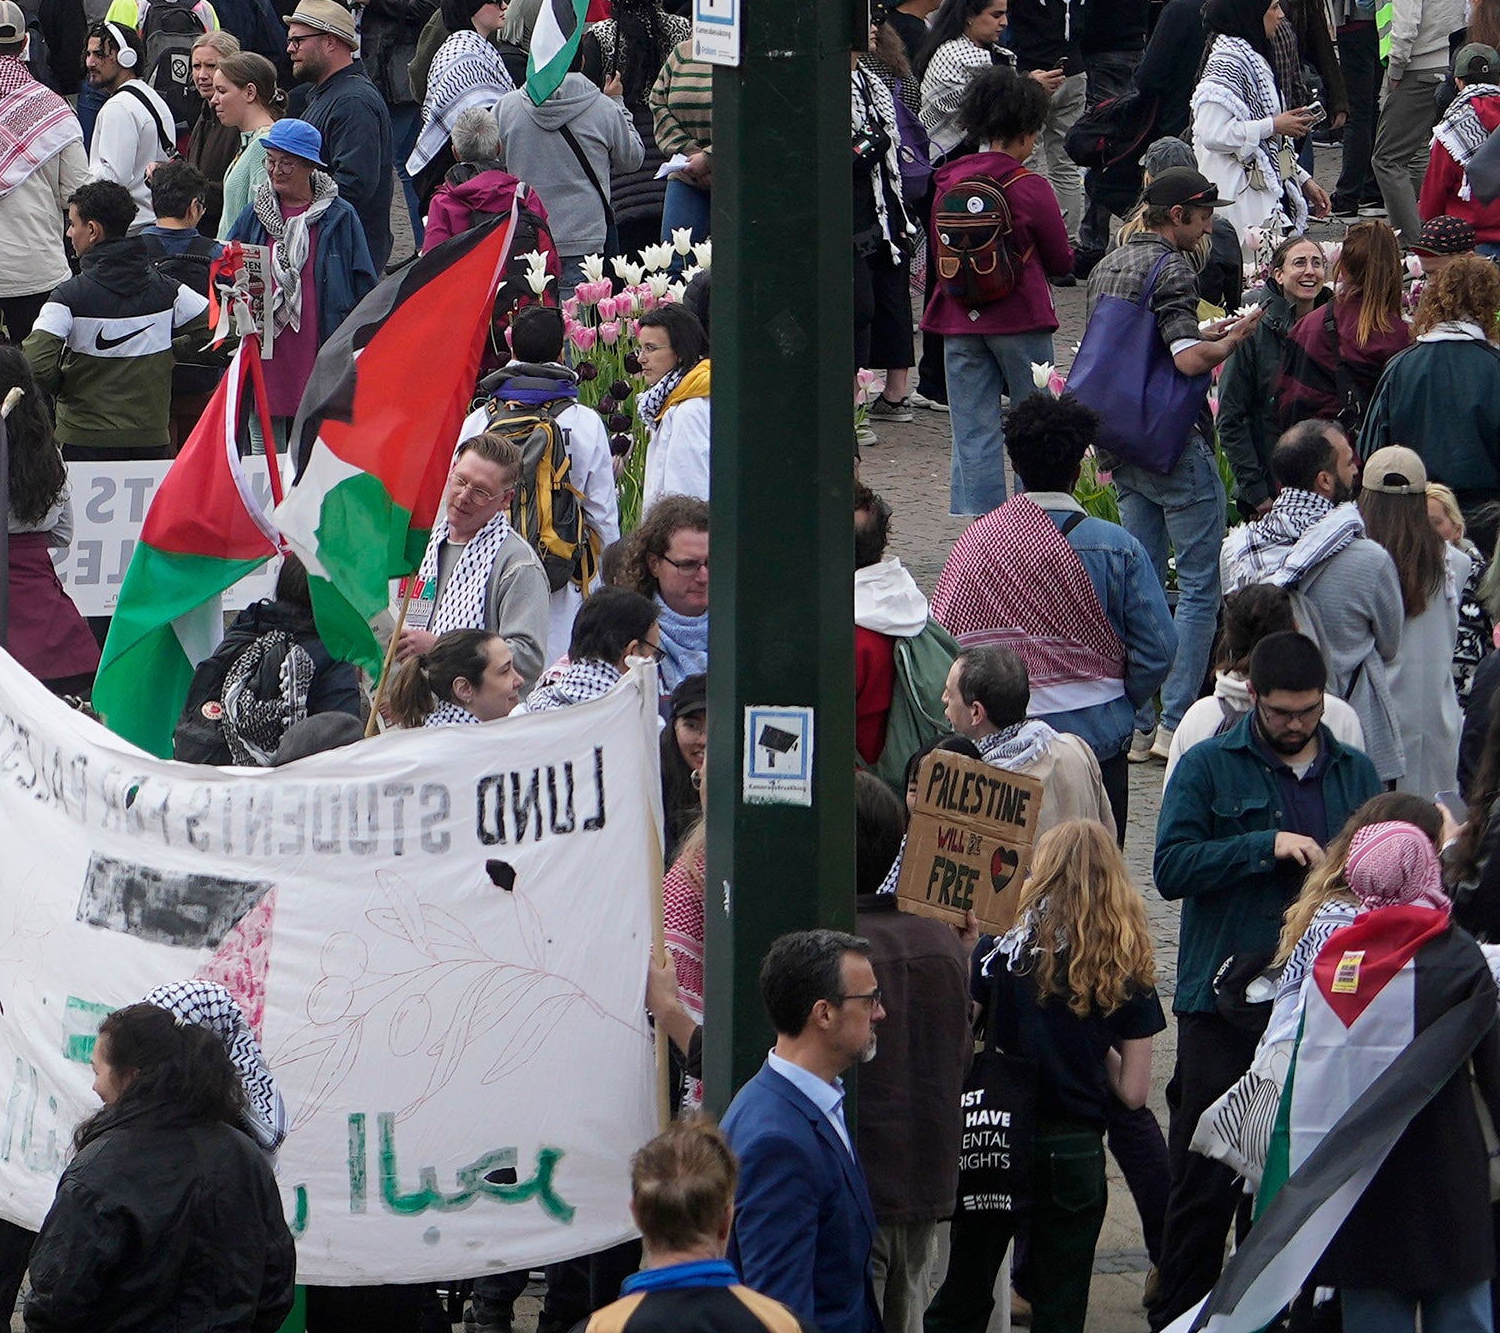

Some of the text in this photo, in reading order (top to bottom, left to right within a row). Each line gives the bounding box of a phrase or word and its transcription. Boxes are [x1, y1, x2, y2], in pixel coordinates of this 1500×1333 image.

[925, 761, 1032, 829] PALESTINE
[936, 825, 966, 854] WILL
[926, 854, 981, 911] FREE
[966, 1110, 1012, 1128] HAVE
[958, 1152, 1011, 1171] RIGHTS
[975, 1194, 1012, 1203] KVINNA
[975, 1202, 1012, 1212] KVINNA
